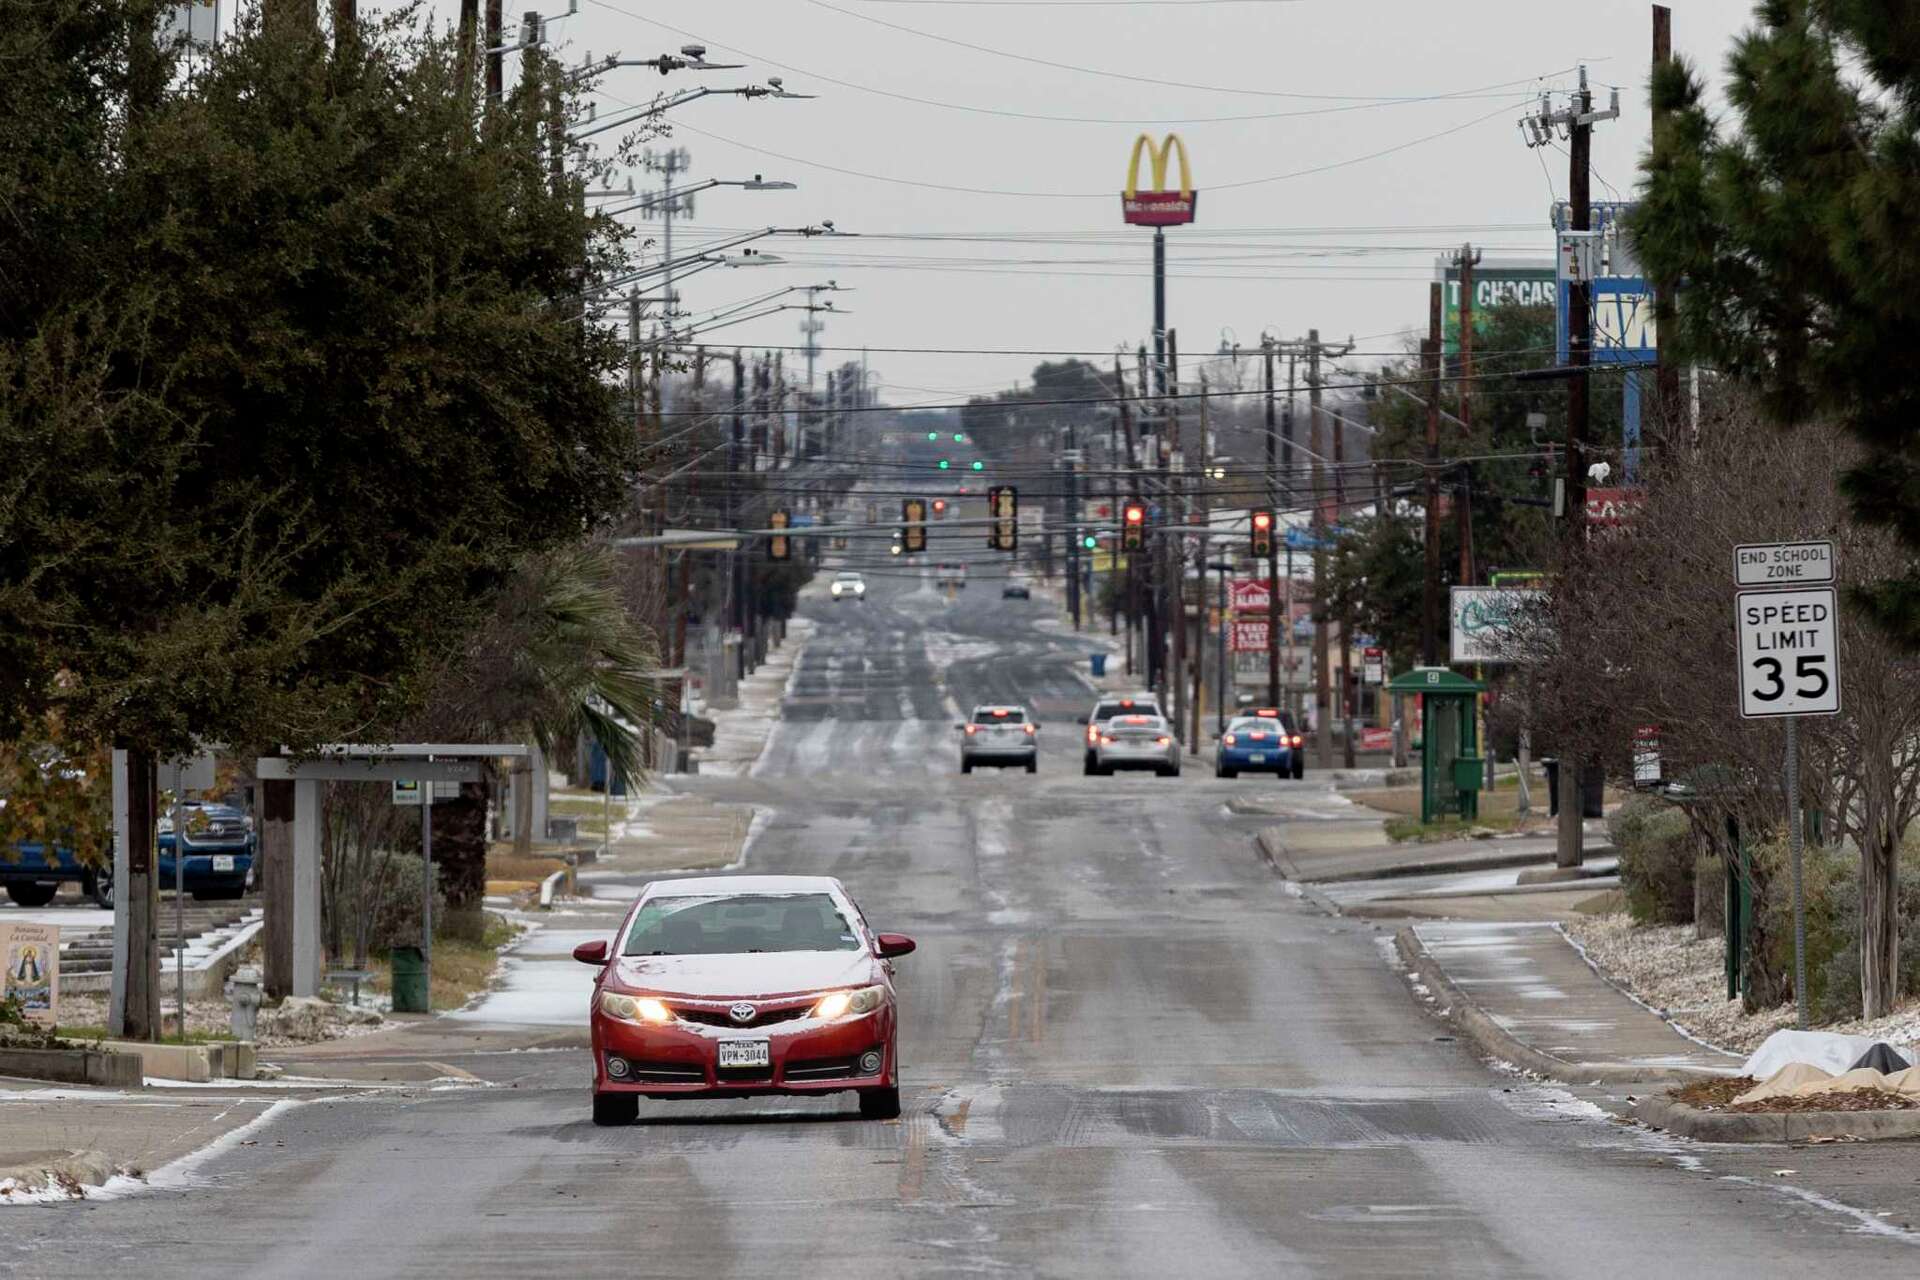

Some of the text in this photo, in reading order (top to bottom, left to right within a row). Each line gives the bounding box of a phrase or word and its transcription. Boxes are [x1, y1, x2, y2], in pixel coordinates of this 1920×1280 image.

[1741, 548, 1828, 564] END SCHOOL
[1767, 564, 1803, 578] ZONE
[1747, 604, 1828, 625] SPEED
[1757, 629, 1819, 651] LIMIT
[1752, 655, 1829, 702] 35
